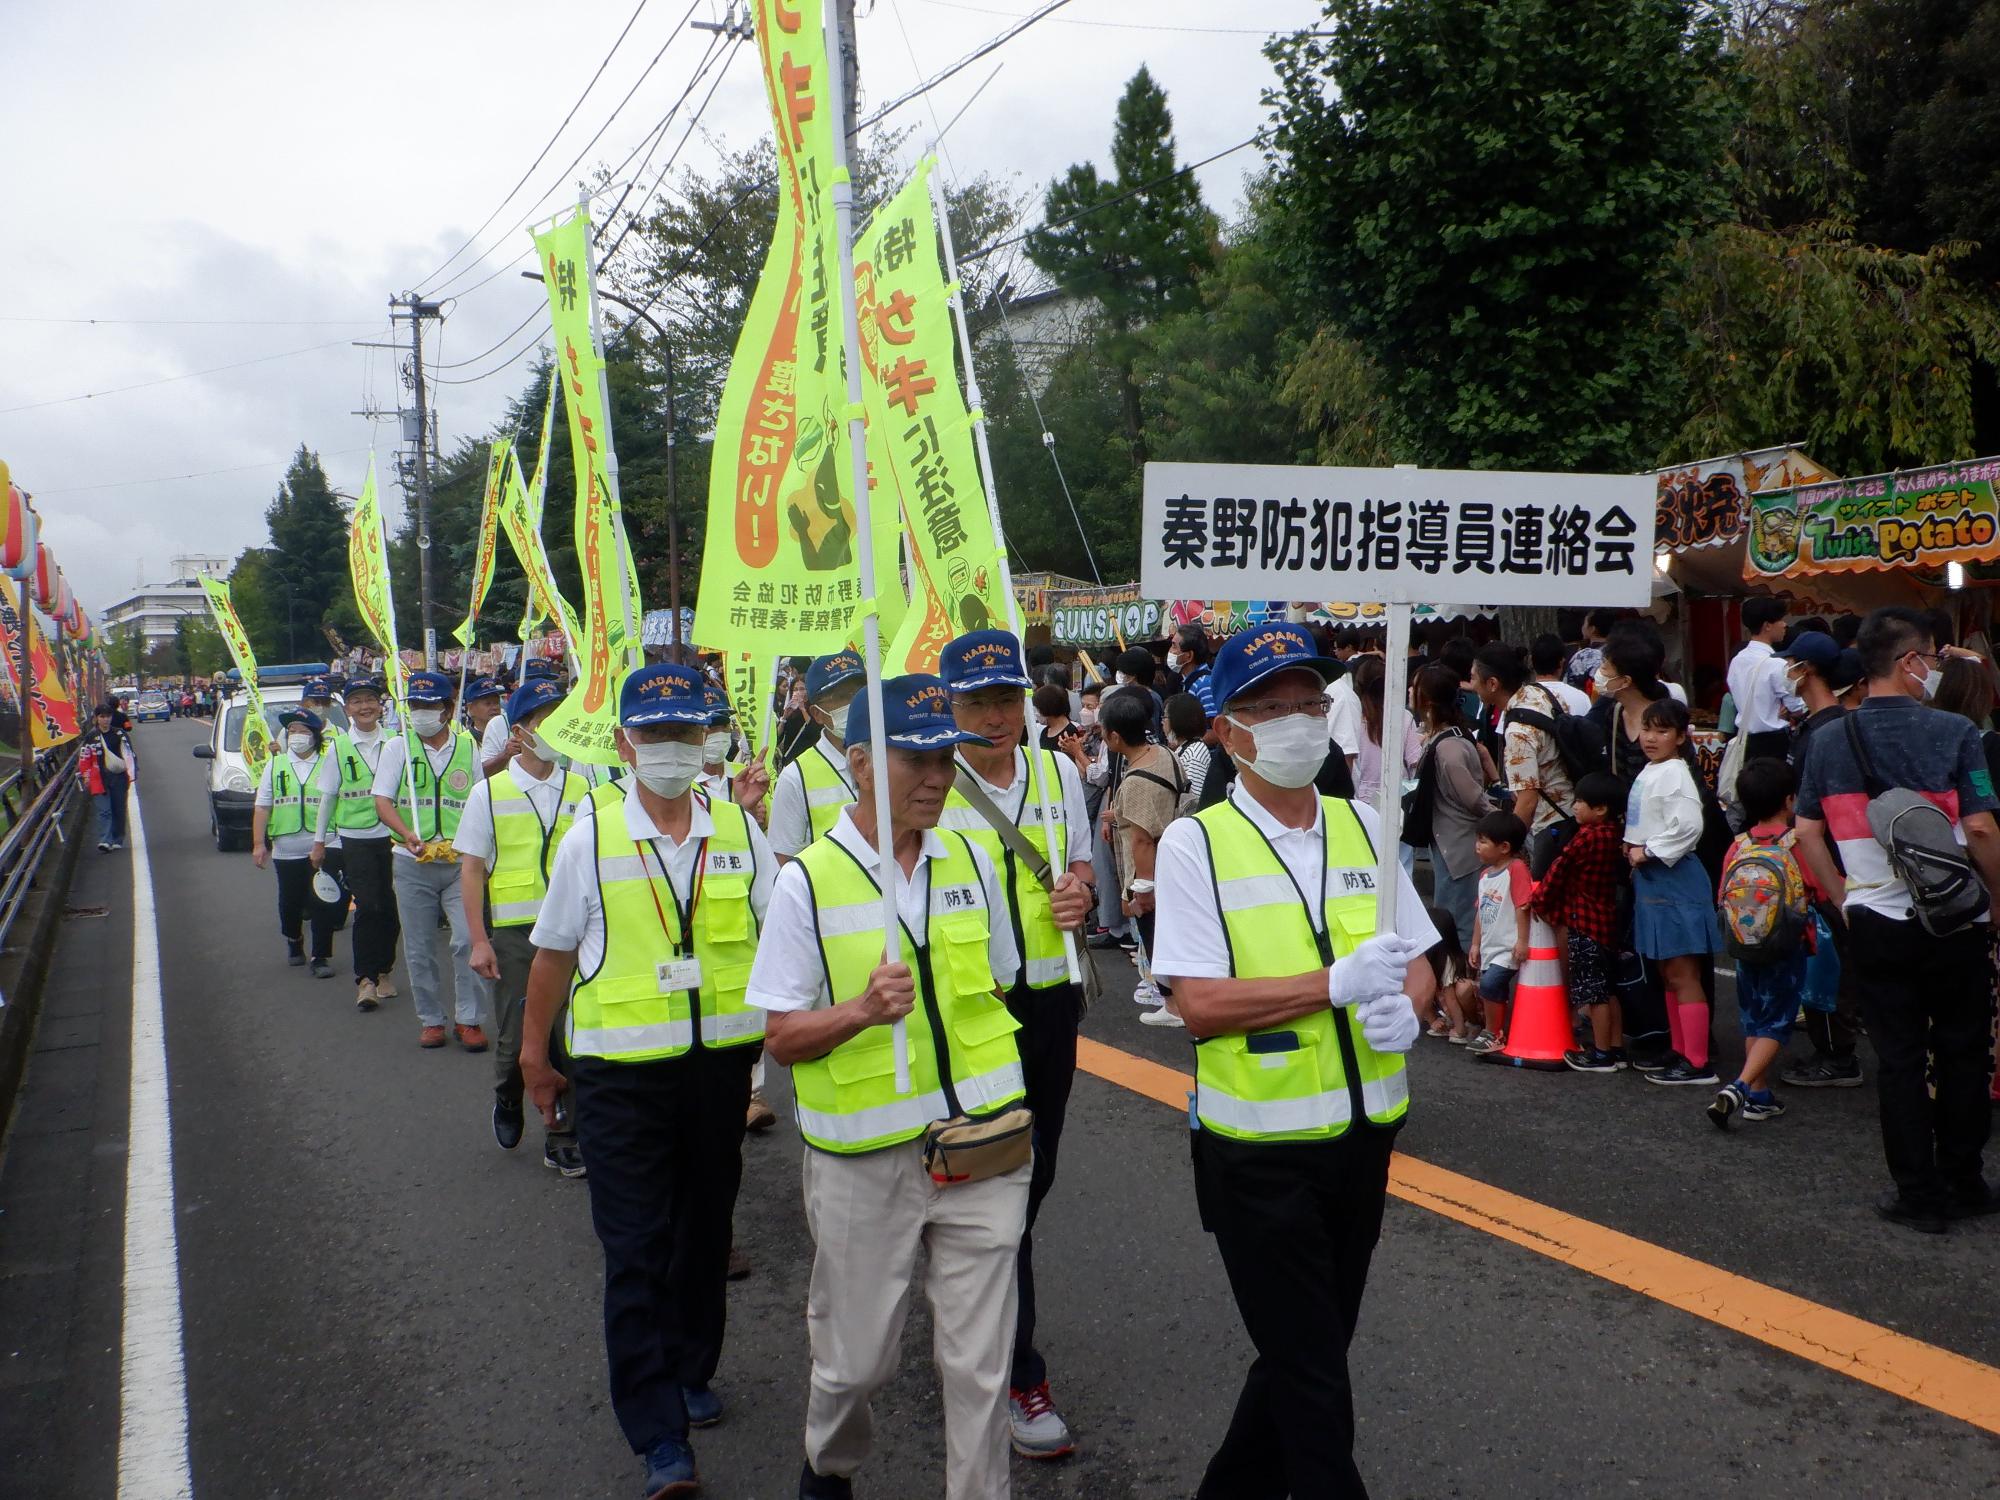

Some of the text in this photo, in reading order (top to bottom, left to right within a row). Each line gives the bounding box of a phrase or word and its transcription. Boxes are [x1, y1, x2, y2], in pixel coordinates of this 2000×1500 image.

[1839, 488, 1976, 521] ツイスト ポテト
[1161, 493, 1637, 576] 秦野防犯指導員連絡会
[1878, 510, 1996, 563] Potato
[961, 644, 1012, 662] HADANO
[1243, 631, 1305, 656] HADANO
[1248, 656, 1270, 670] CRIME
[713, 855, 742, 870] 防犯
[1342, 872, 1376, 890] 防犯
[944, 888, 975, 908] 防犯
